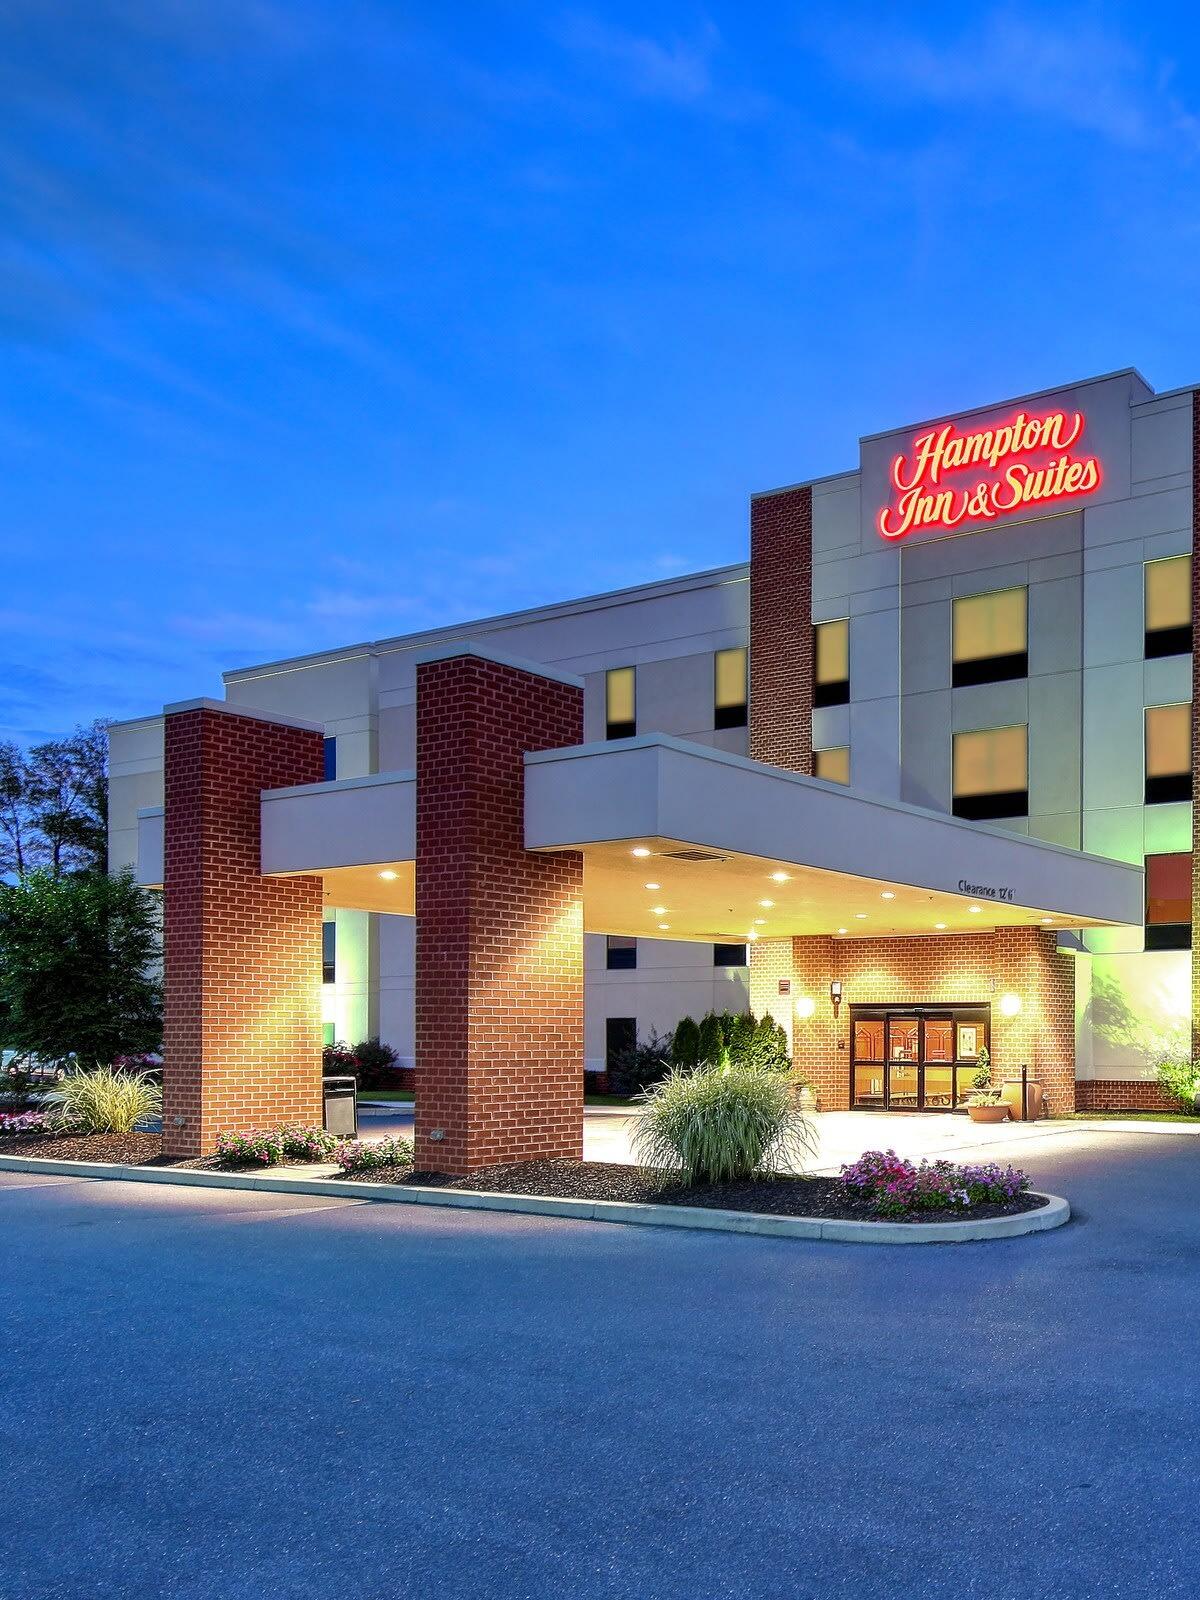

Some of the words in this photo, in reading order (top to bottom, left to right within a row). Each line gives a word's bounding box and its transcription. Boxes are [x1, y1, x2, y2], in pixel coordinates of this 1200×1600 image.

[894, 413, 1082, 491] Hampton
[880, 486, 969, 537] Inn
[967, 482, 996, 517] &
[991, 455, 1098, 509] Suites
[958, 879, 997, 898] Clearance
